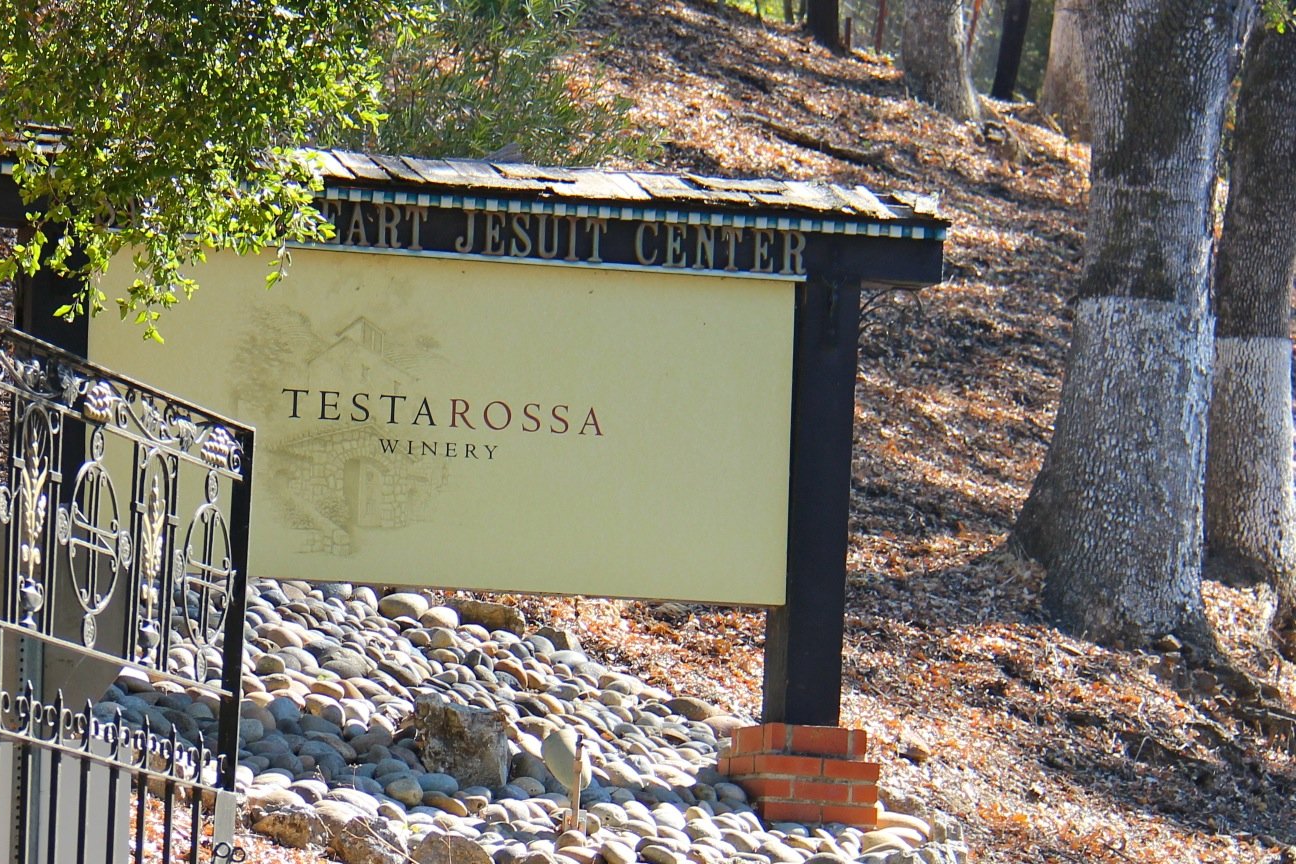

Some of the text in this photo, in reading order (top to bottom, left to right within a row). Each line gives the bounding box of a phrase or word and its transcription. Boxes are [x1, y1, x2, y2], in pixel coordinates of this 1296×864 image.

[304, 199, 808, 276] EART JESUIT CENTER
[281, 387, 604, 437] TESTAROSSA
[378, 437, 499, 461] WINERY
